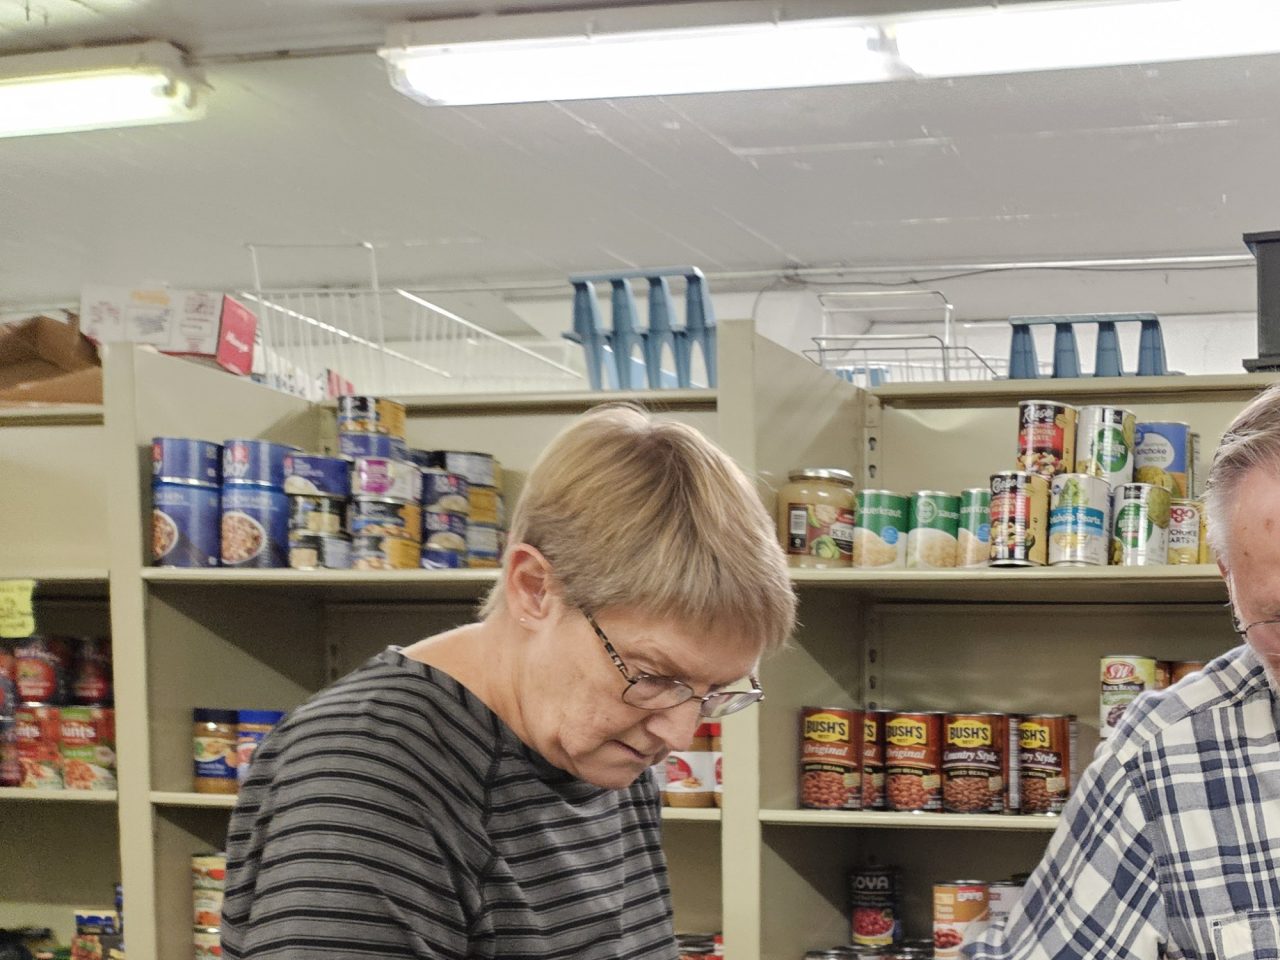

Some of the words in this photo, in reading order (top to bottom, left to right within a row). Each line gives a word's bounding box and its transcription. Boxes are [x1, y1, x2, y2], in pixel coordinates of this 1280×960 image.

[806, 720, 846, 736] BUSH'S
[950, 726, 989, 741] BUSH'S
[805, 743, 848, 757] Original
[976, 750, 998, 763] Style
